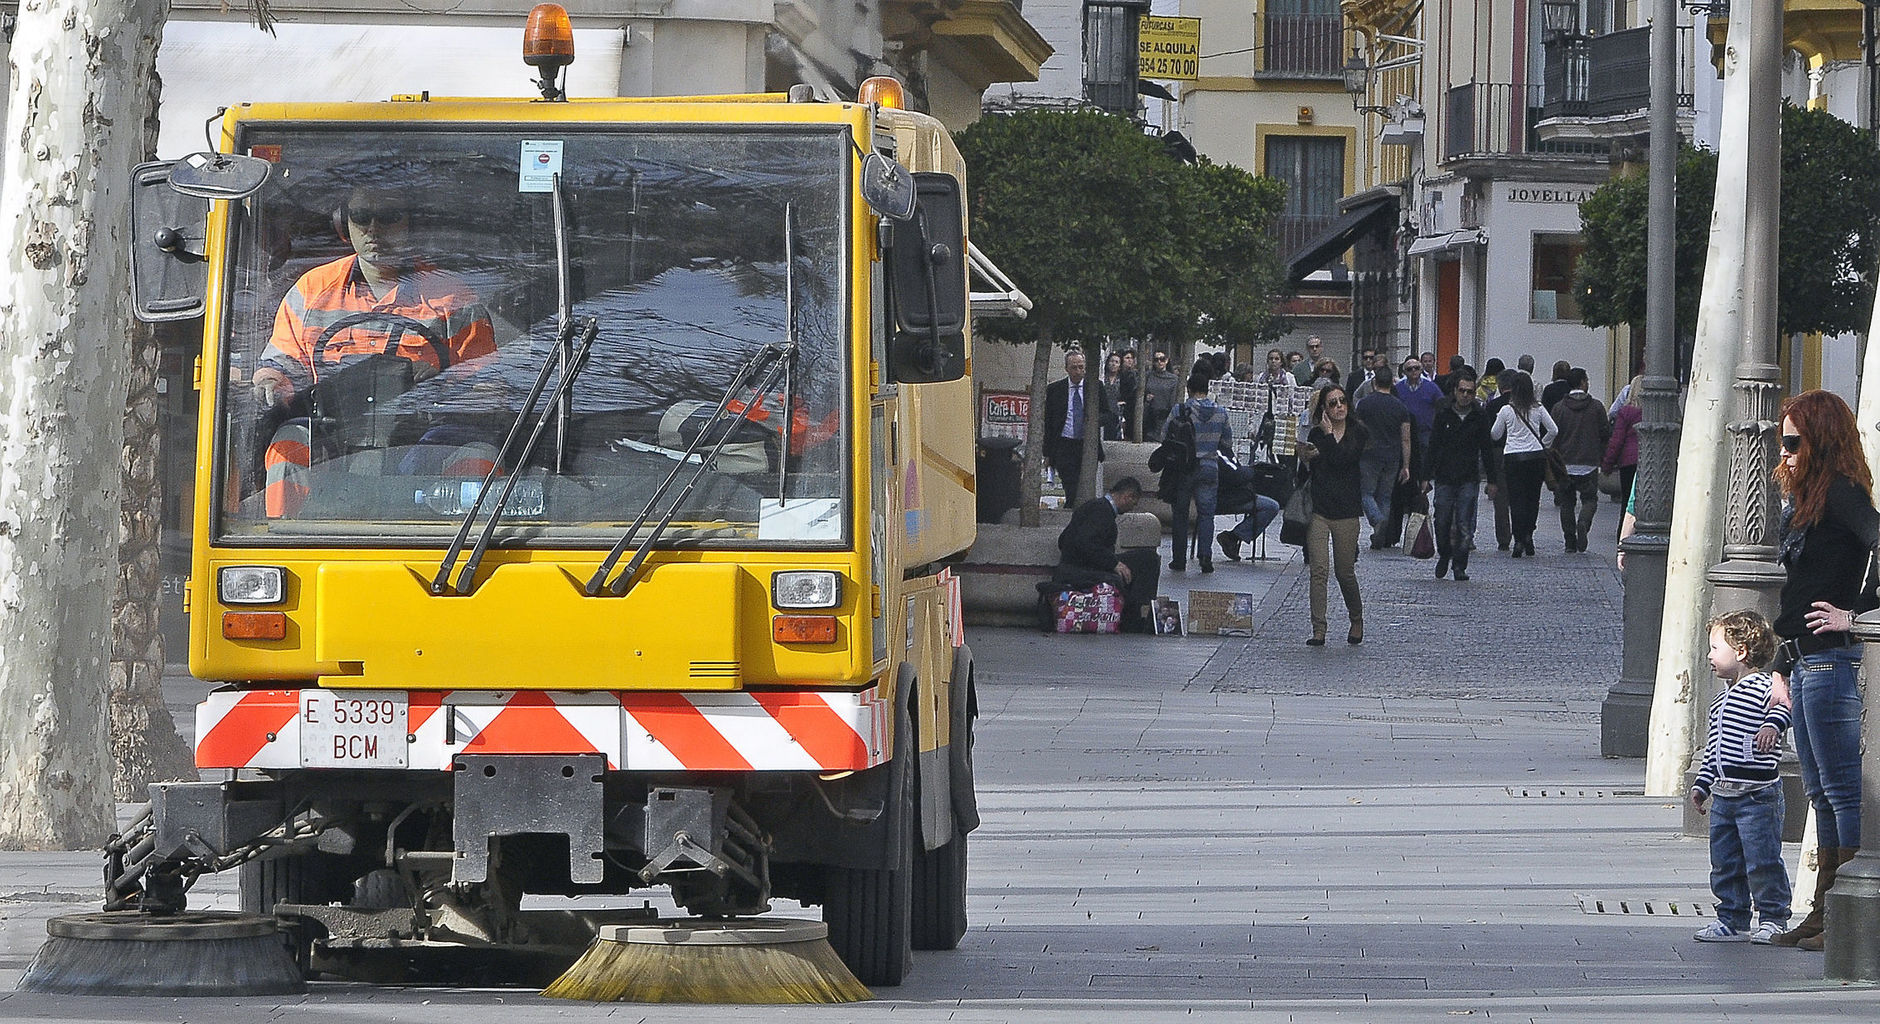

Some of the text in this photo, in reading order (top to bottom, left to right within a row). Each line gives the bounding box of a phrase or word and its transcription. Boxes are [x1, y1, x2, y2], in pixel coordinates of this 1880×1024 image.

[1140, 41, 1197, 55] SE ALQUILA
[1140, 57, 1196, 76] 954 25 70 00
[306, 699, 394, 724] E 5339
[334, 735, 378, 760] BCM
